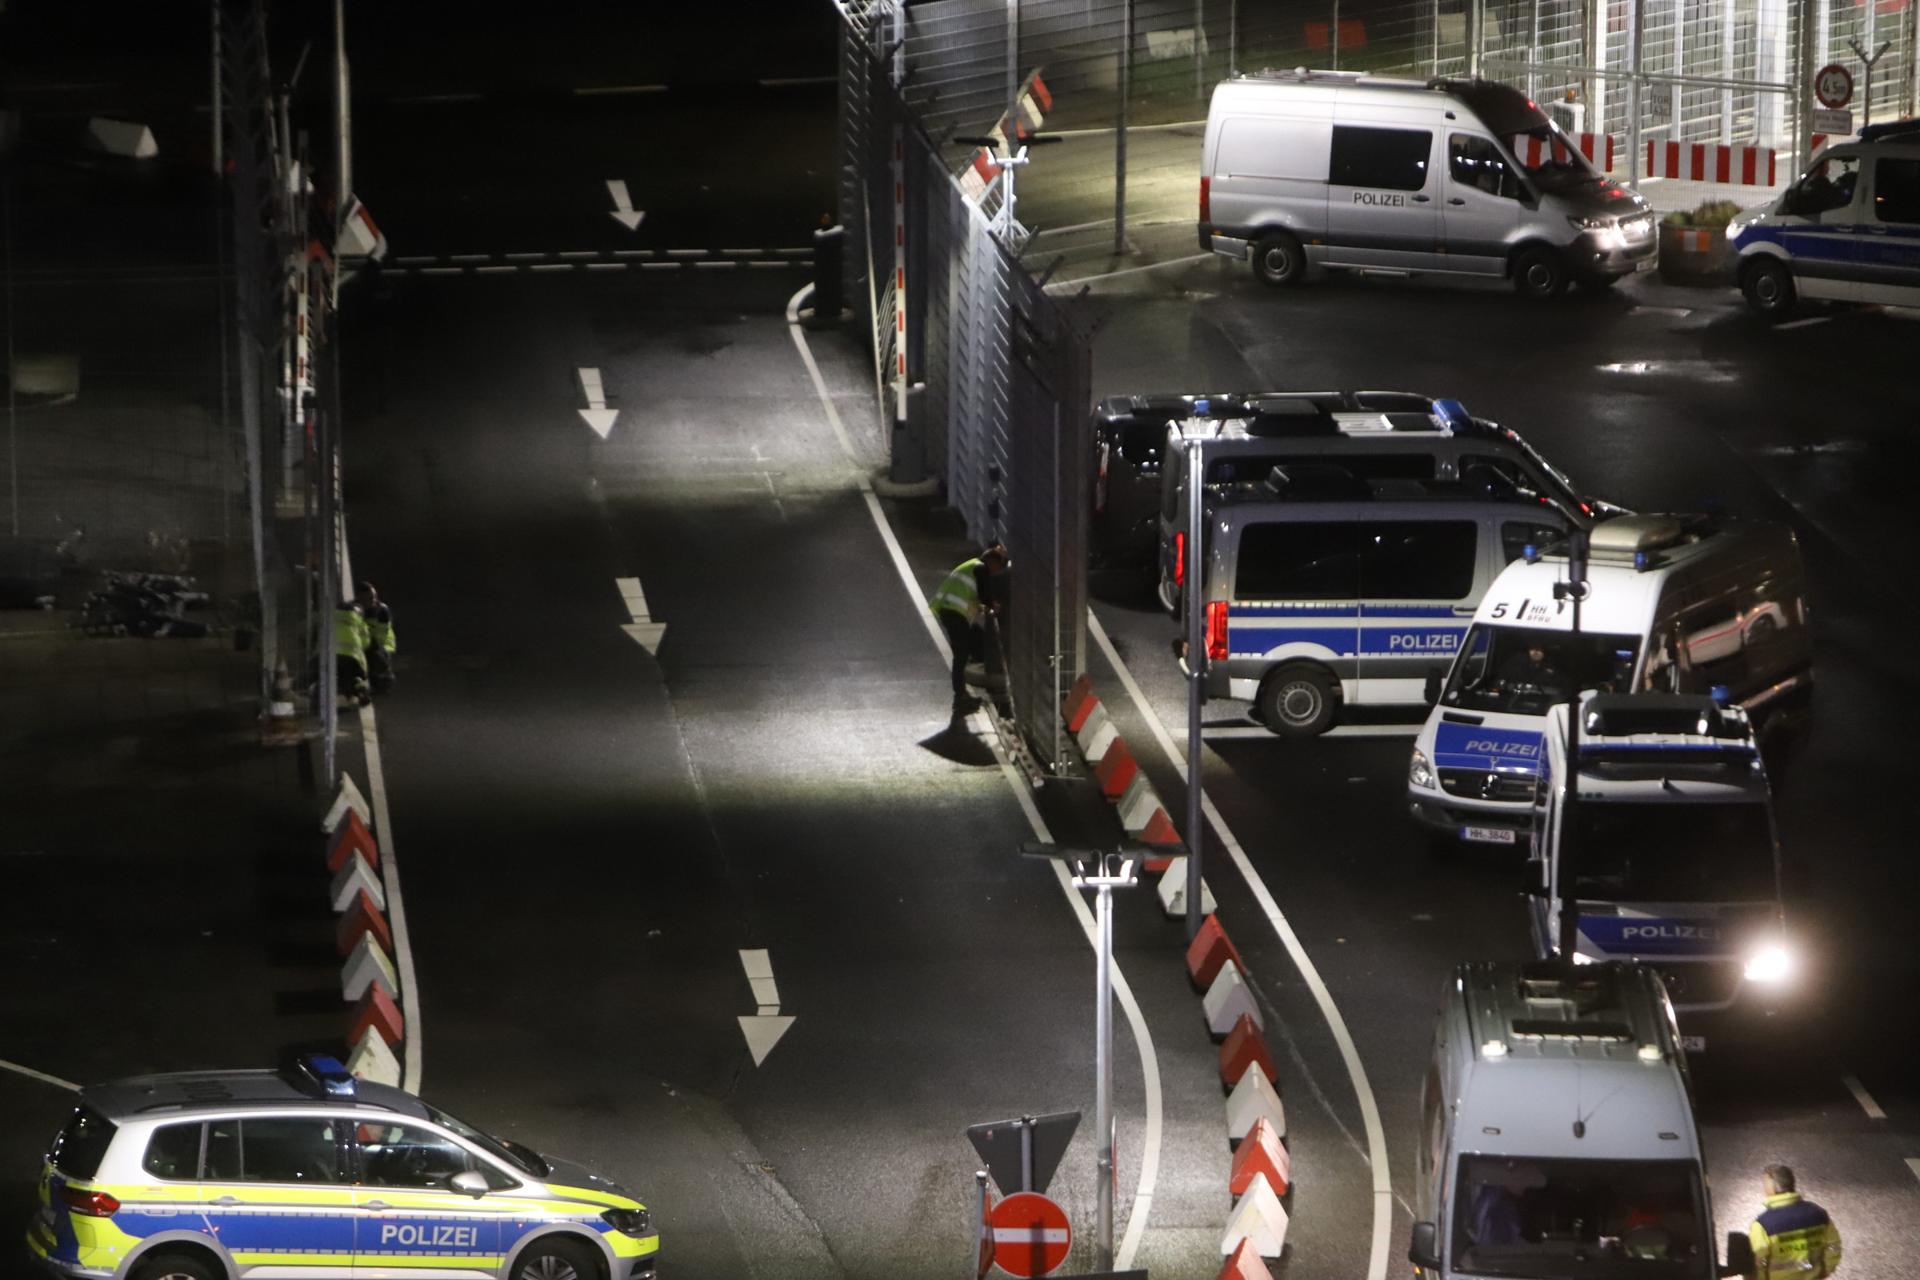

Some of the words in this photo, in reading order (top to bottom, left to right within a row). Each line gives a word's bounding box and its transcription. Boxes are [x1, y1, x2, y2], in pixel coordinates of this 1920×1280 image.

[1353, 192, 1405, 207] POLIZEI
[1491, 602, 1509, 619] 5
[1389, 634, 1458, 649] POLIZEI
[1465, 740, 1538, 757] POLIZEI
[381, 1224, 478, 1247] POLIZEI
